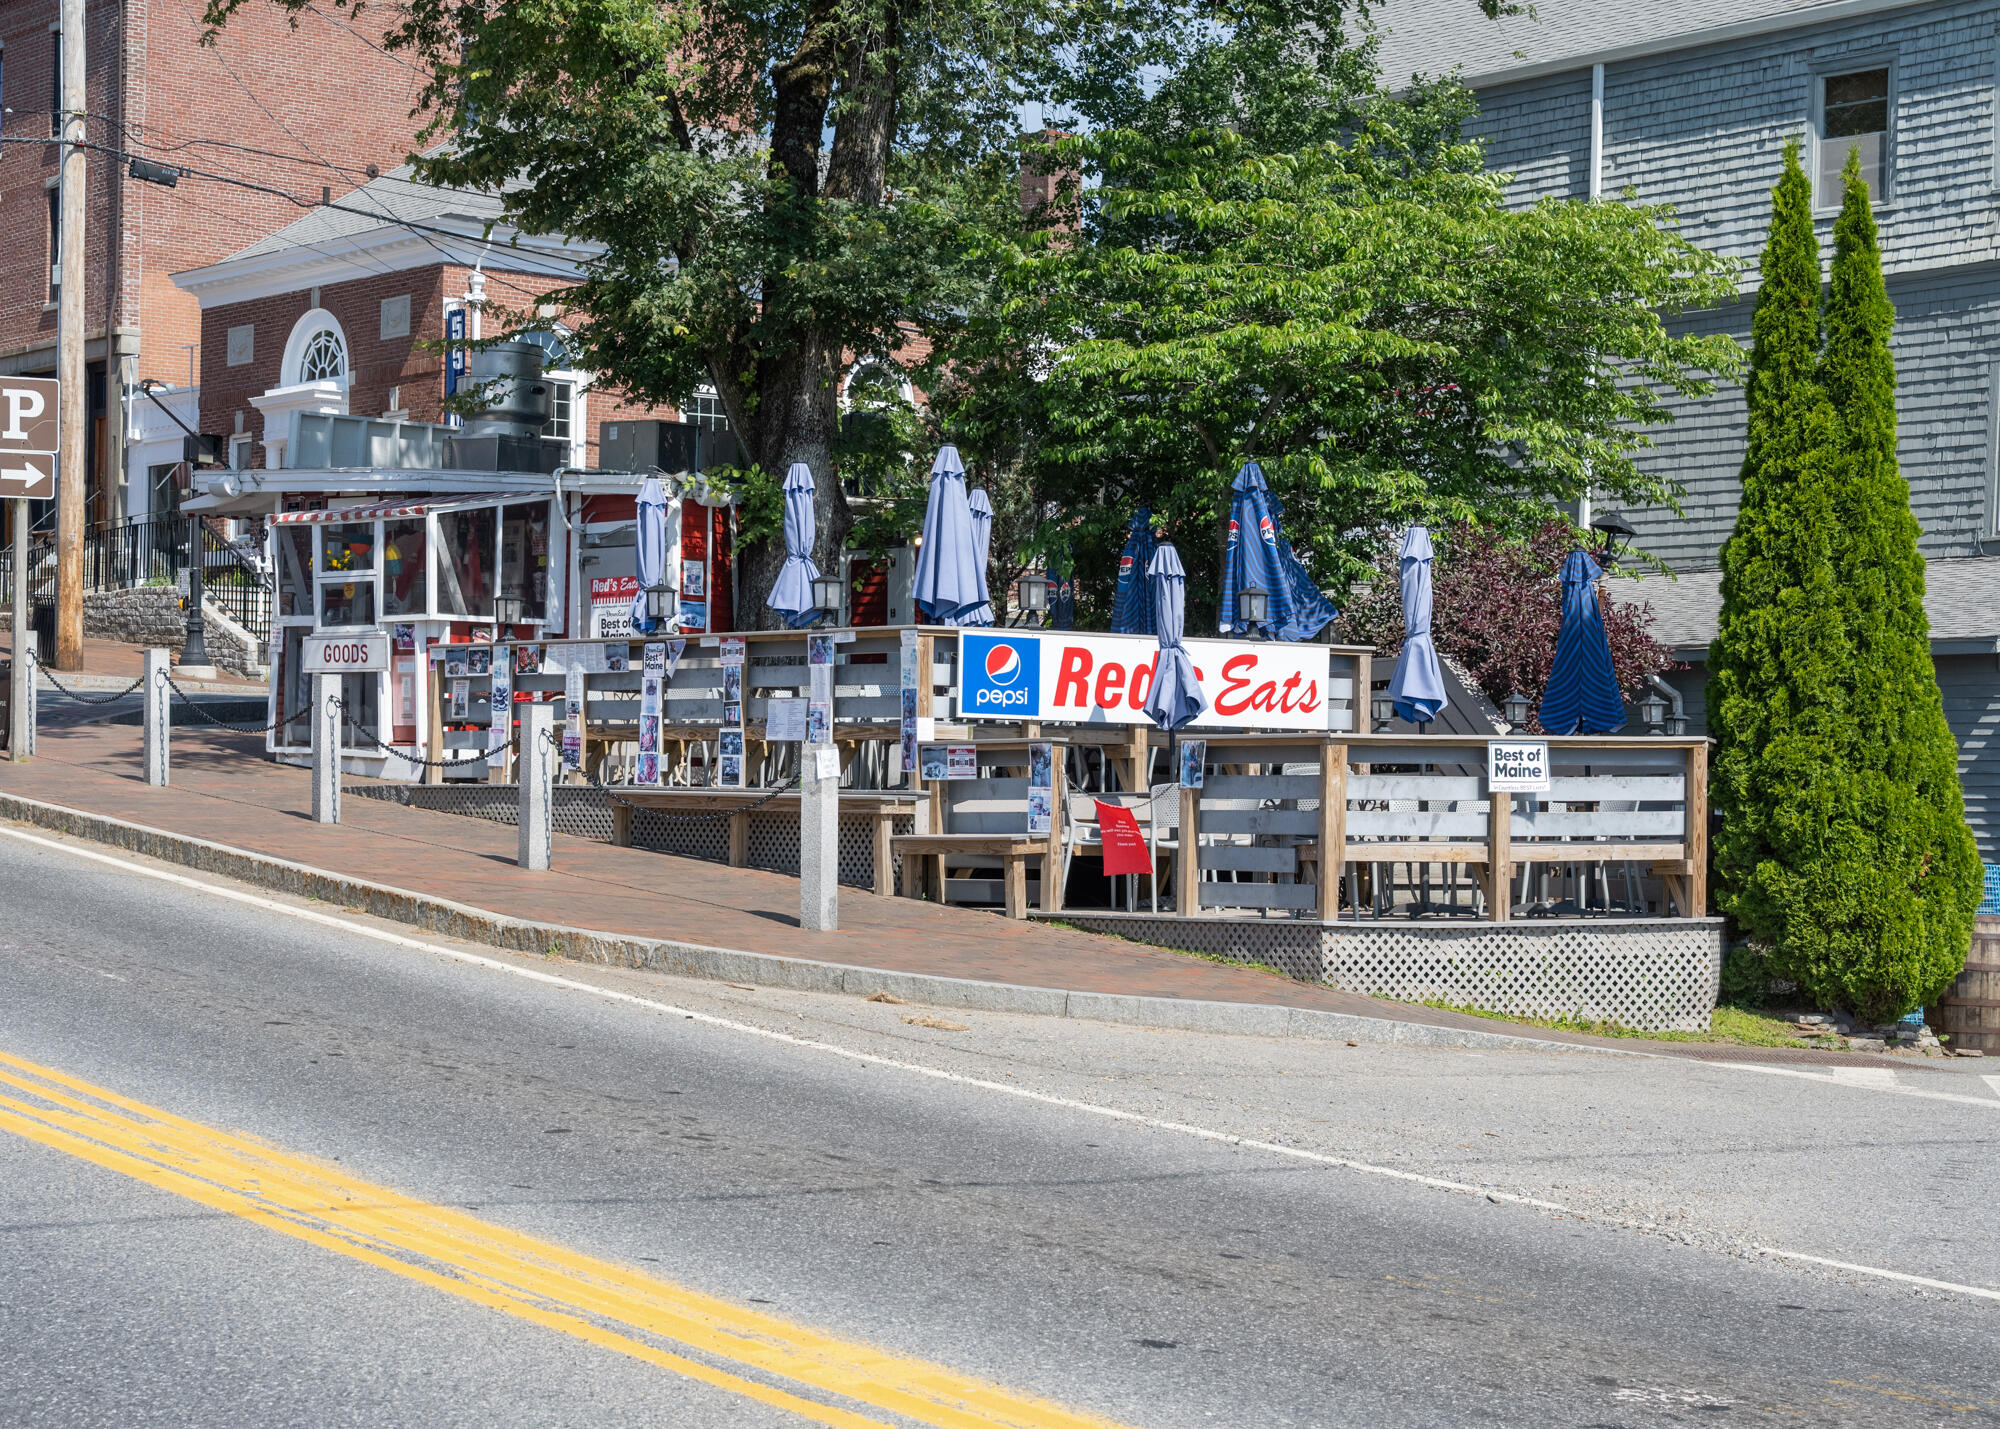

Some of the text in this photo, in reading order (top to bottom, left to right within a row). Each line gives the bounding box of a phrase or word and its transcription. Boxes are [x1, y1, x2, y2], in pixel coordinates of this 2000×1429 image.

[2, 388, 45, 440] P
[592, 577, 639, 592] Red's Eats
[601, 616, 632, 630] Best of
[324, 644, 368, 663] GOODS
[645, 653, 658, 662] Best
[645, 661, 663, 669] Maine
[1214, 653, 1322, 716] Eats
[976, 687, 1028, 708] pepsi
[1495, 748, 1541, 761] Best of
[1495, 762, 1542, 777] Maine
